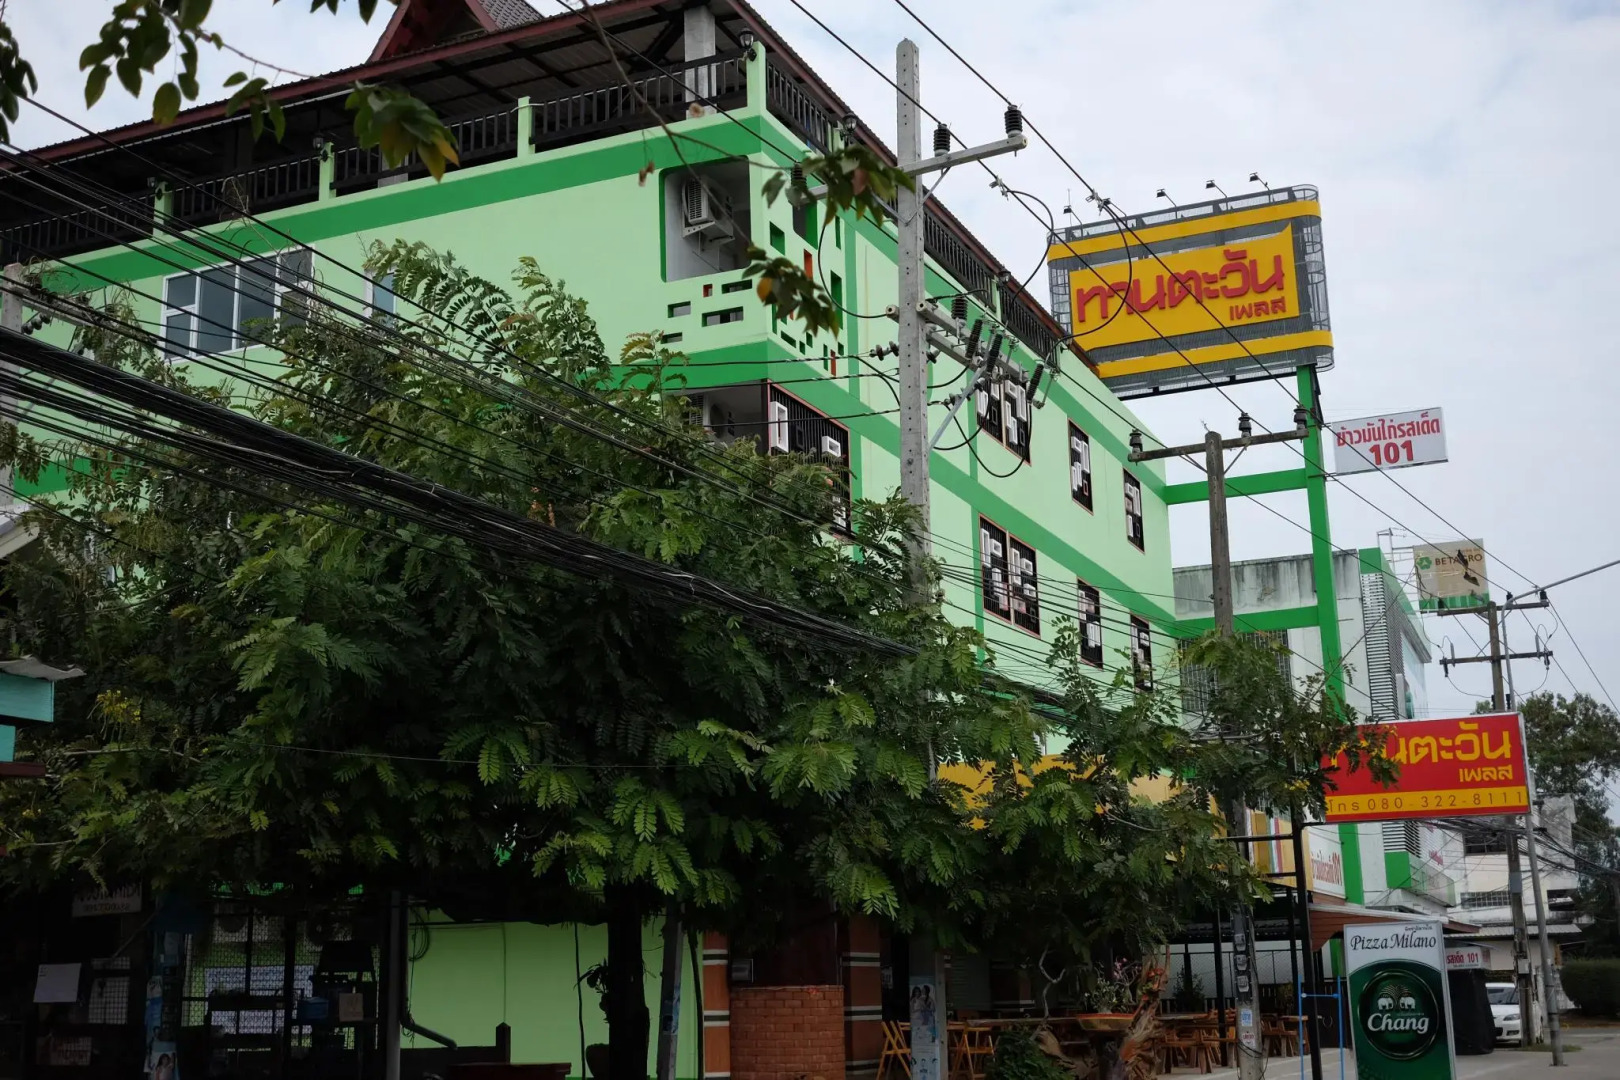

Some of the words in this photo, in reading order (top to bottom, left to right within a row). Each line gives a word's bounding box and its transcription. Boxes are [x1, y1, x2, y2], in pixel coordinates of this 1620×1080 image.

[1076, 249, 1285, 323] ทานตะวัน
[1229, 296, 1287, 321] เพลส
[1336, 411, 1441, 447] ข้าวมันไก่รสเด็ด
[1369, 440, 1414, 466] 101
[1434, 553, 1483, 566] BETARO
[1330, 721, 1512, 768] นตะวัน
[1459, 764, 1513, 783] เพลส
[1350, 935, 1388, 950] Pizza
[1389, 930, 1437, 949] Milano
[1467, 952, 1479, 963] 101
[1367, 1012, 1430, 1034] Chang
